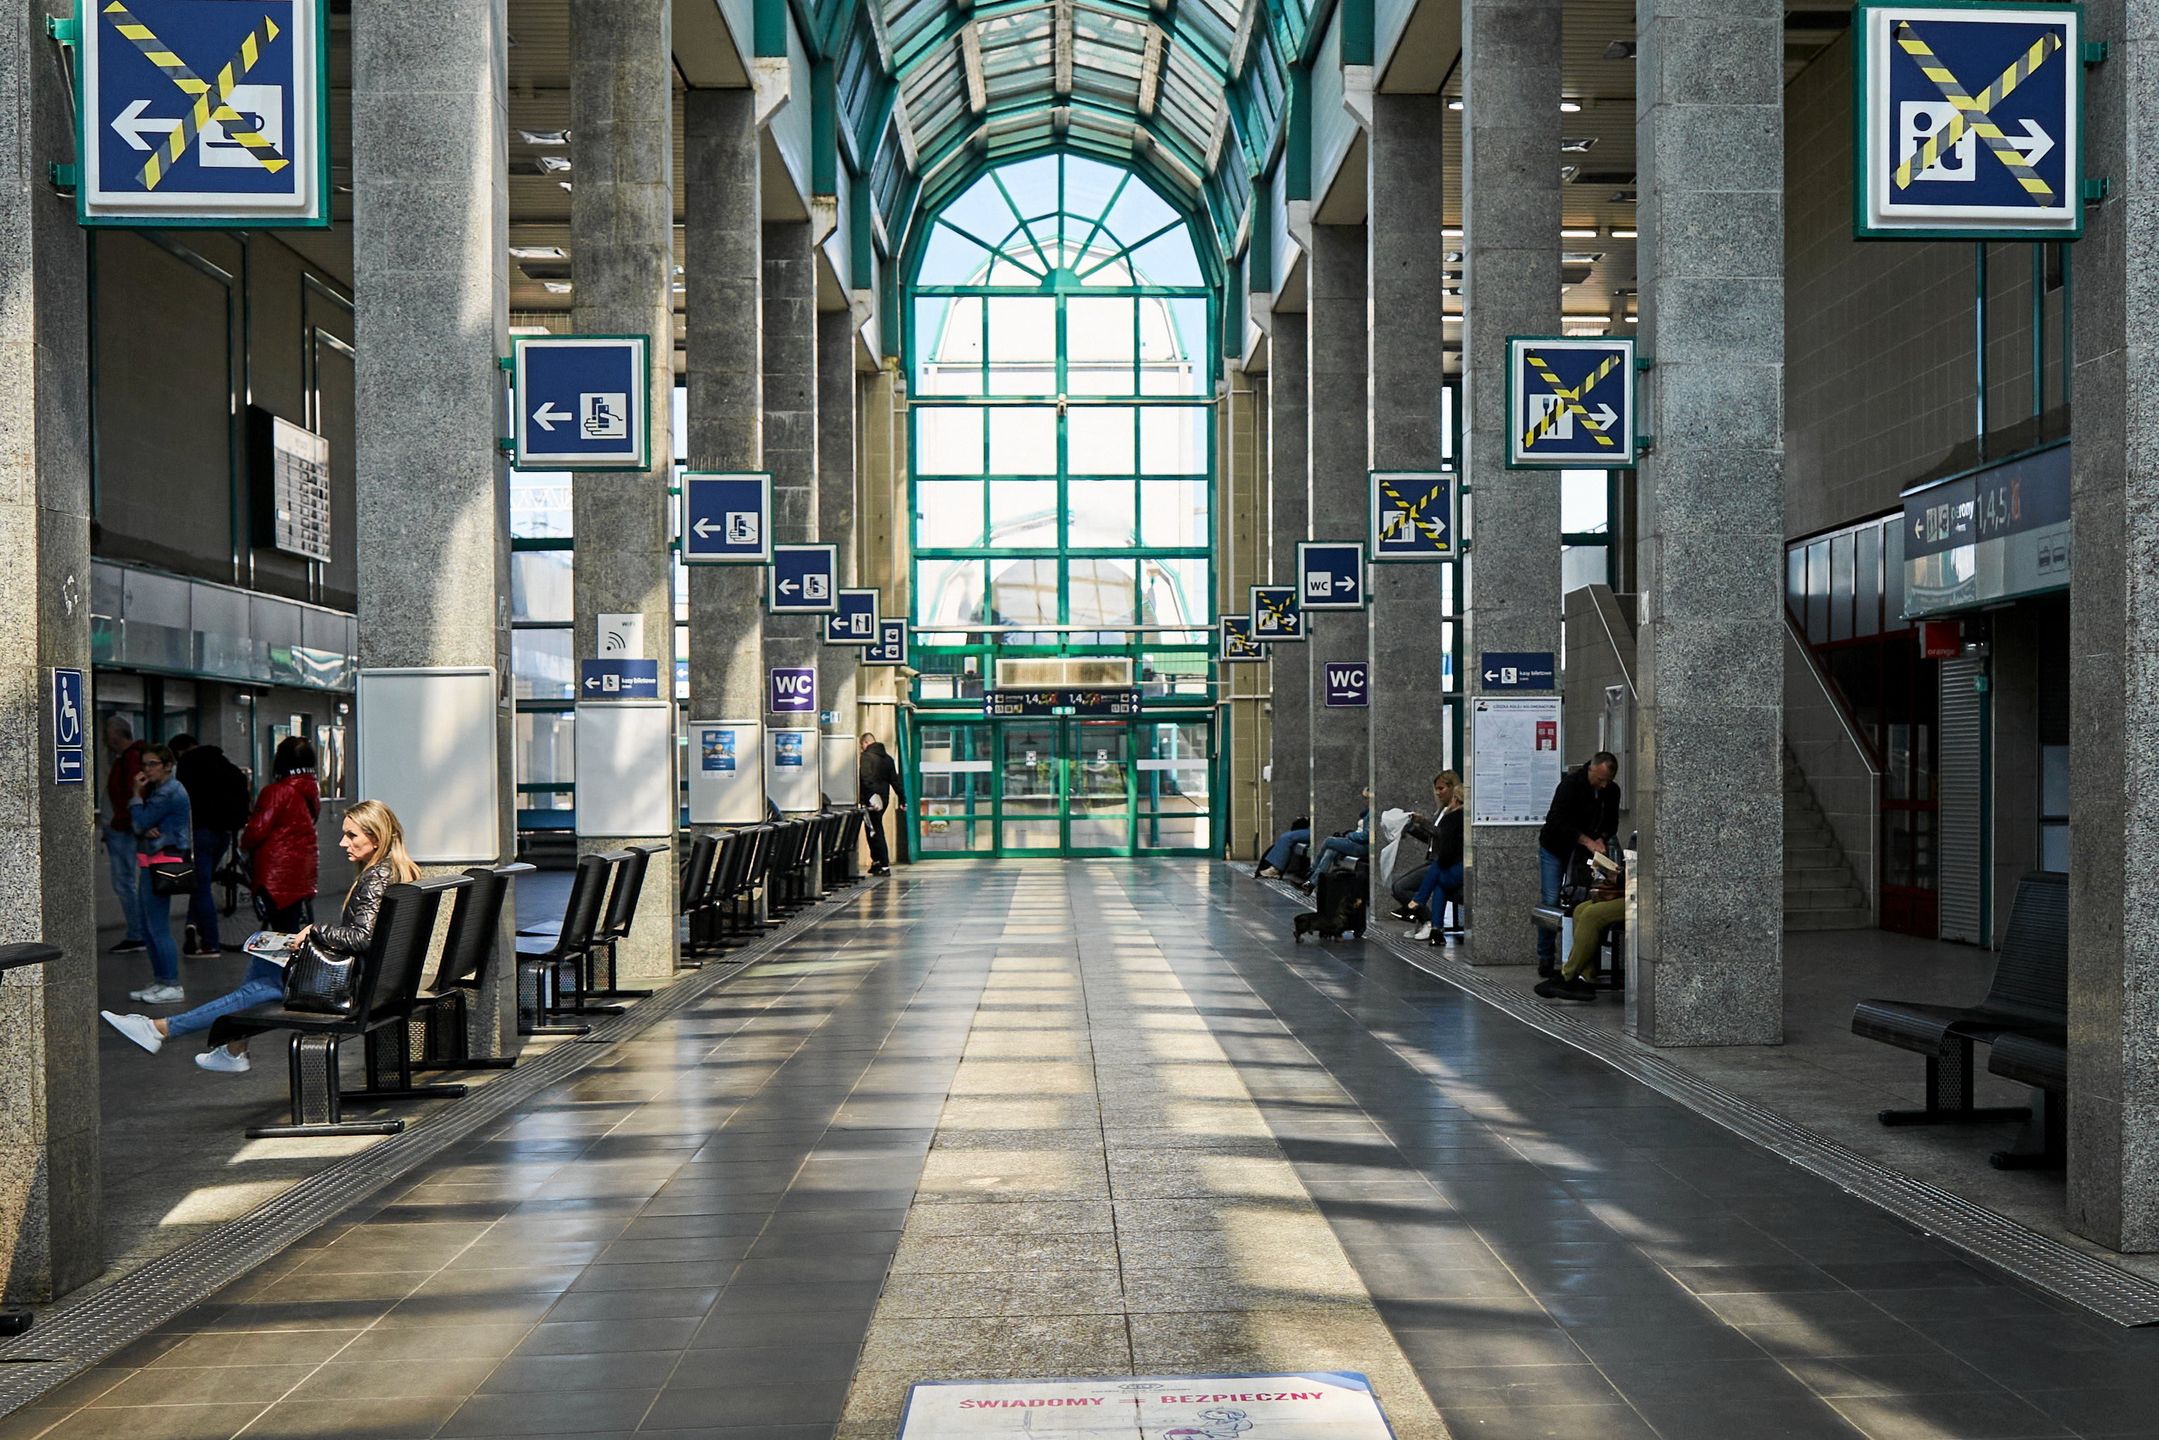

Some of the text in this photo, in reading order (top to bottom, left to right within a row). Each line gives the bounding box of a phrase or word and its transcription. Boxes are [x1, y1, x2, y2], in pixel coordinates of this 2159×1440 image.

[1310, 581, 1329, 591] WC
[1927, 648, 1956, 656] orange
[775, 675, 813, 694] WC
[1330, 670, 1365, 688] WC
[958, 1396, 1105, 1409] ŚWIADOMY
[1160, 1391, 1324, 1404] BEZPIECZNY
